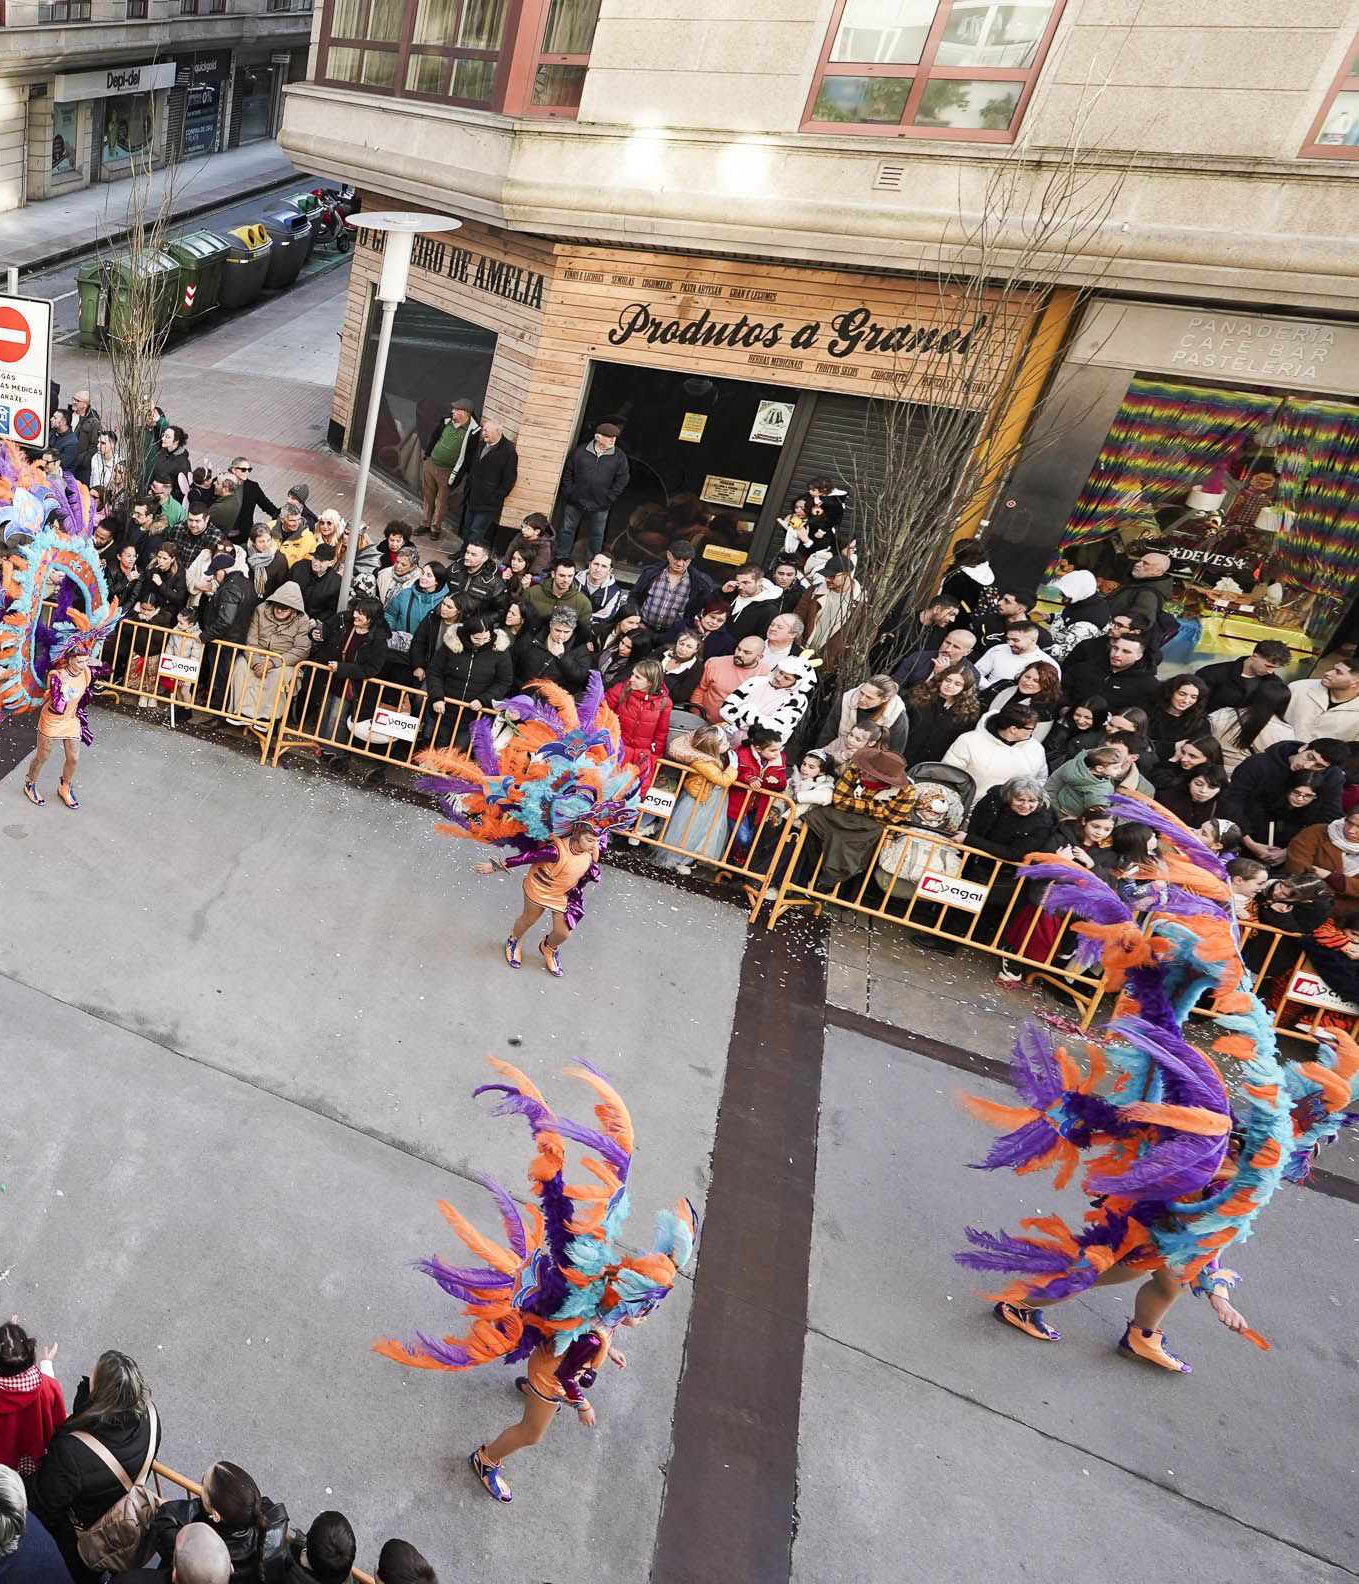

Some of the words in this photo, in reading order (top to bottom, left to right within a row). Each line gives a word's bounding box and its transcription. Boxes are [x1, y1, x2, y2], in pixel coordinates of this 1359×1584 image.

[447, 247, 472, 284] DE
[473, 255, 545, 310] AMELIA
[608, 303, 784, 349] Produtos
[790, 321, 821, 350] a
[828, 307, 988, 358] Granel
